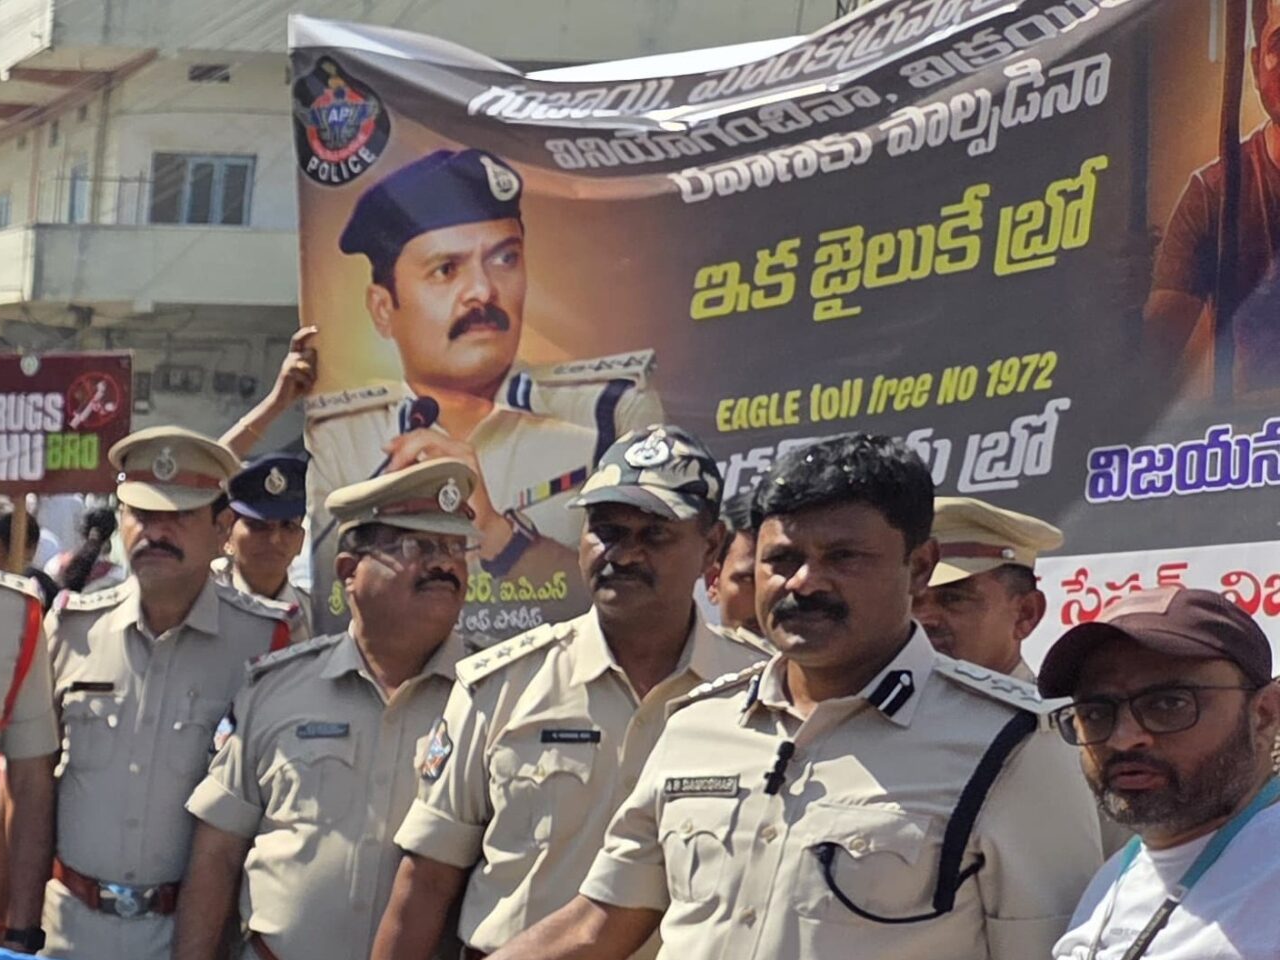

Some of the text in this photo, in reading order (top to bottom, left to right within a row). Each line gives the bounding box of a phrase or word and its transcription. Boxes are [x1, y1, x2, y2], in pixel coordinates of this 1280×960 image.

[306, 145, 376, 183] POLICE
[689, 154, 1109, 322] ఇక జైలుకే బ్రో
[716, 350, 1058, 432] EAGLE toll free NO 1972
[46, 431, 100, 471] BRO
[956, 397, 1071, 494] బ్రో
